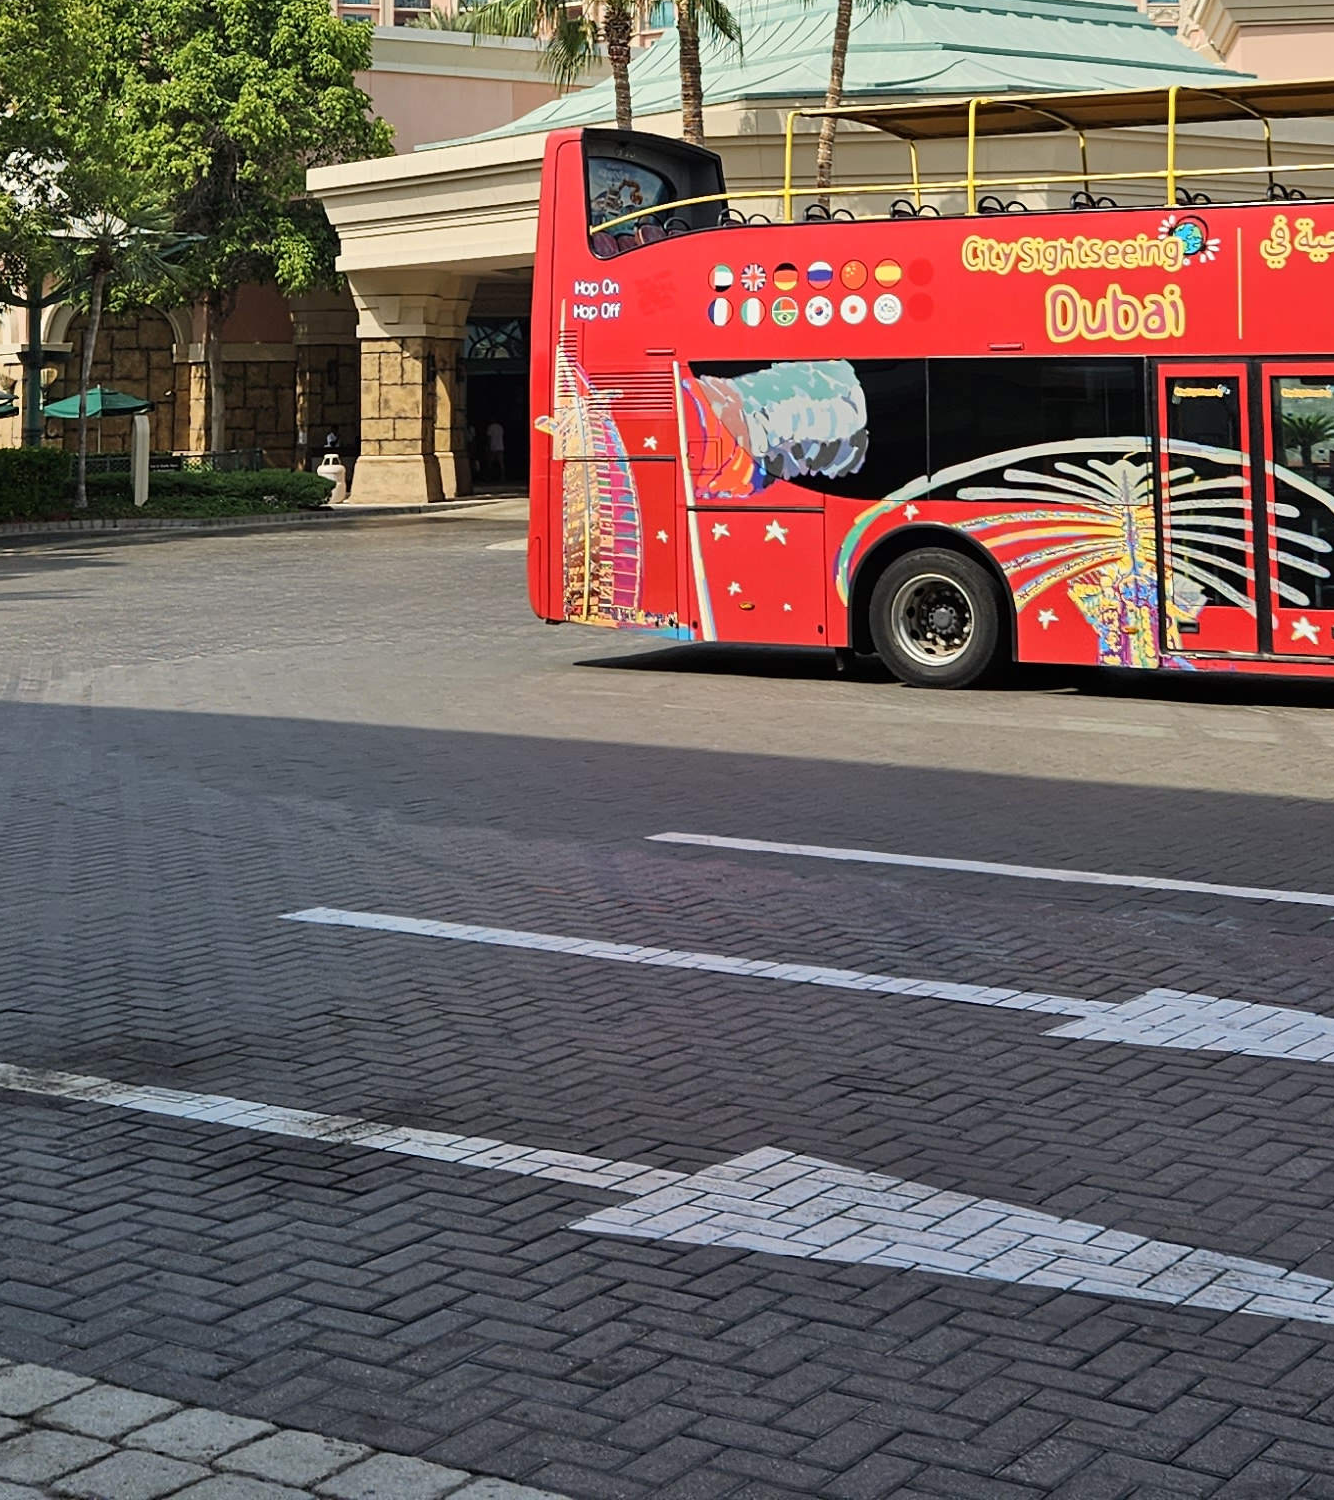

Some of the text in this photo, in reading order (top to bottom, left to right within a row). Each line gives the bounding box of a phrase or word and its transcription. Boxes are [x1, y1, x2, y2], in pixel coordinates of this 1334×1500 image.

[1260, 215, 1292, 268] في
[574, 278, 620, 297] Hop On
[573, 302, 621, 320] Hop Off
[1045, 284, 1185, 342] Dubai
